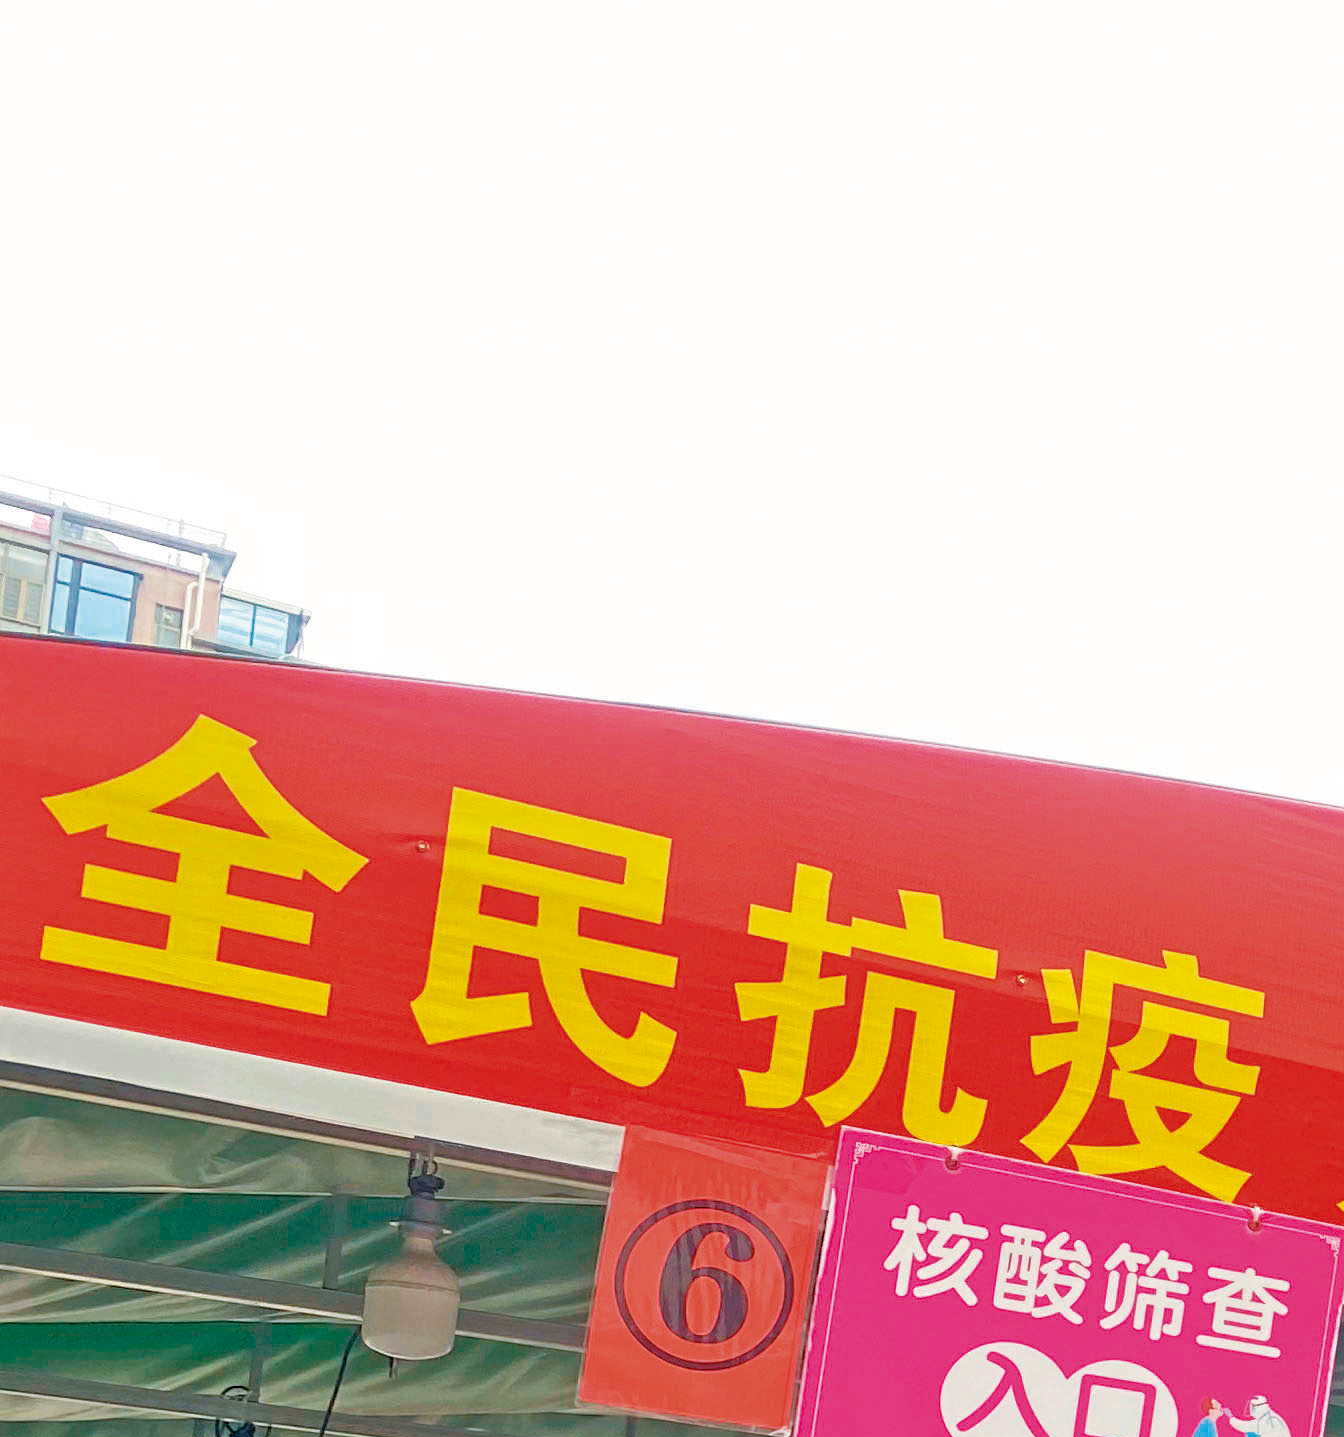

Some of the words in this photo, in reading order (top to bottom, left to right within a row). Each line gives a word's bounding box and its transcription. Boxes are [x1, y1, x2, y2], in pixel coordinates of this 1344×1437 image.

[40, 713, 1264, 1202] 全民抗疫
[881, 1204, 1291, 1360] 核酸筛查
